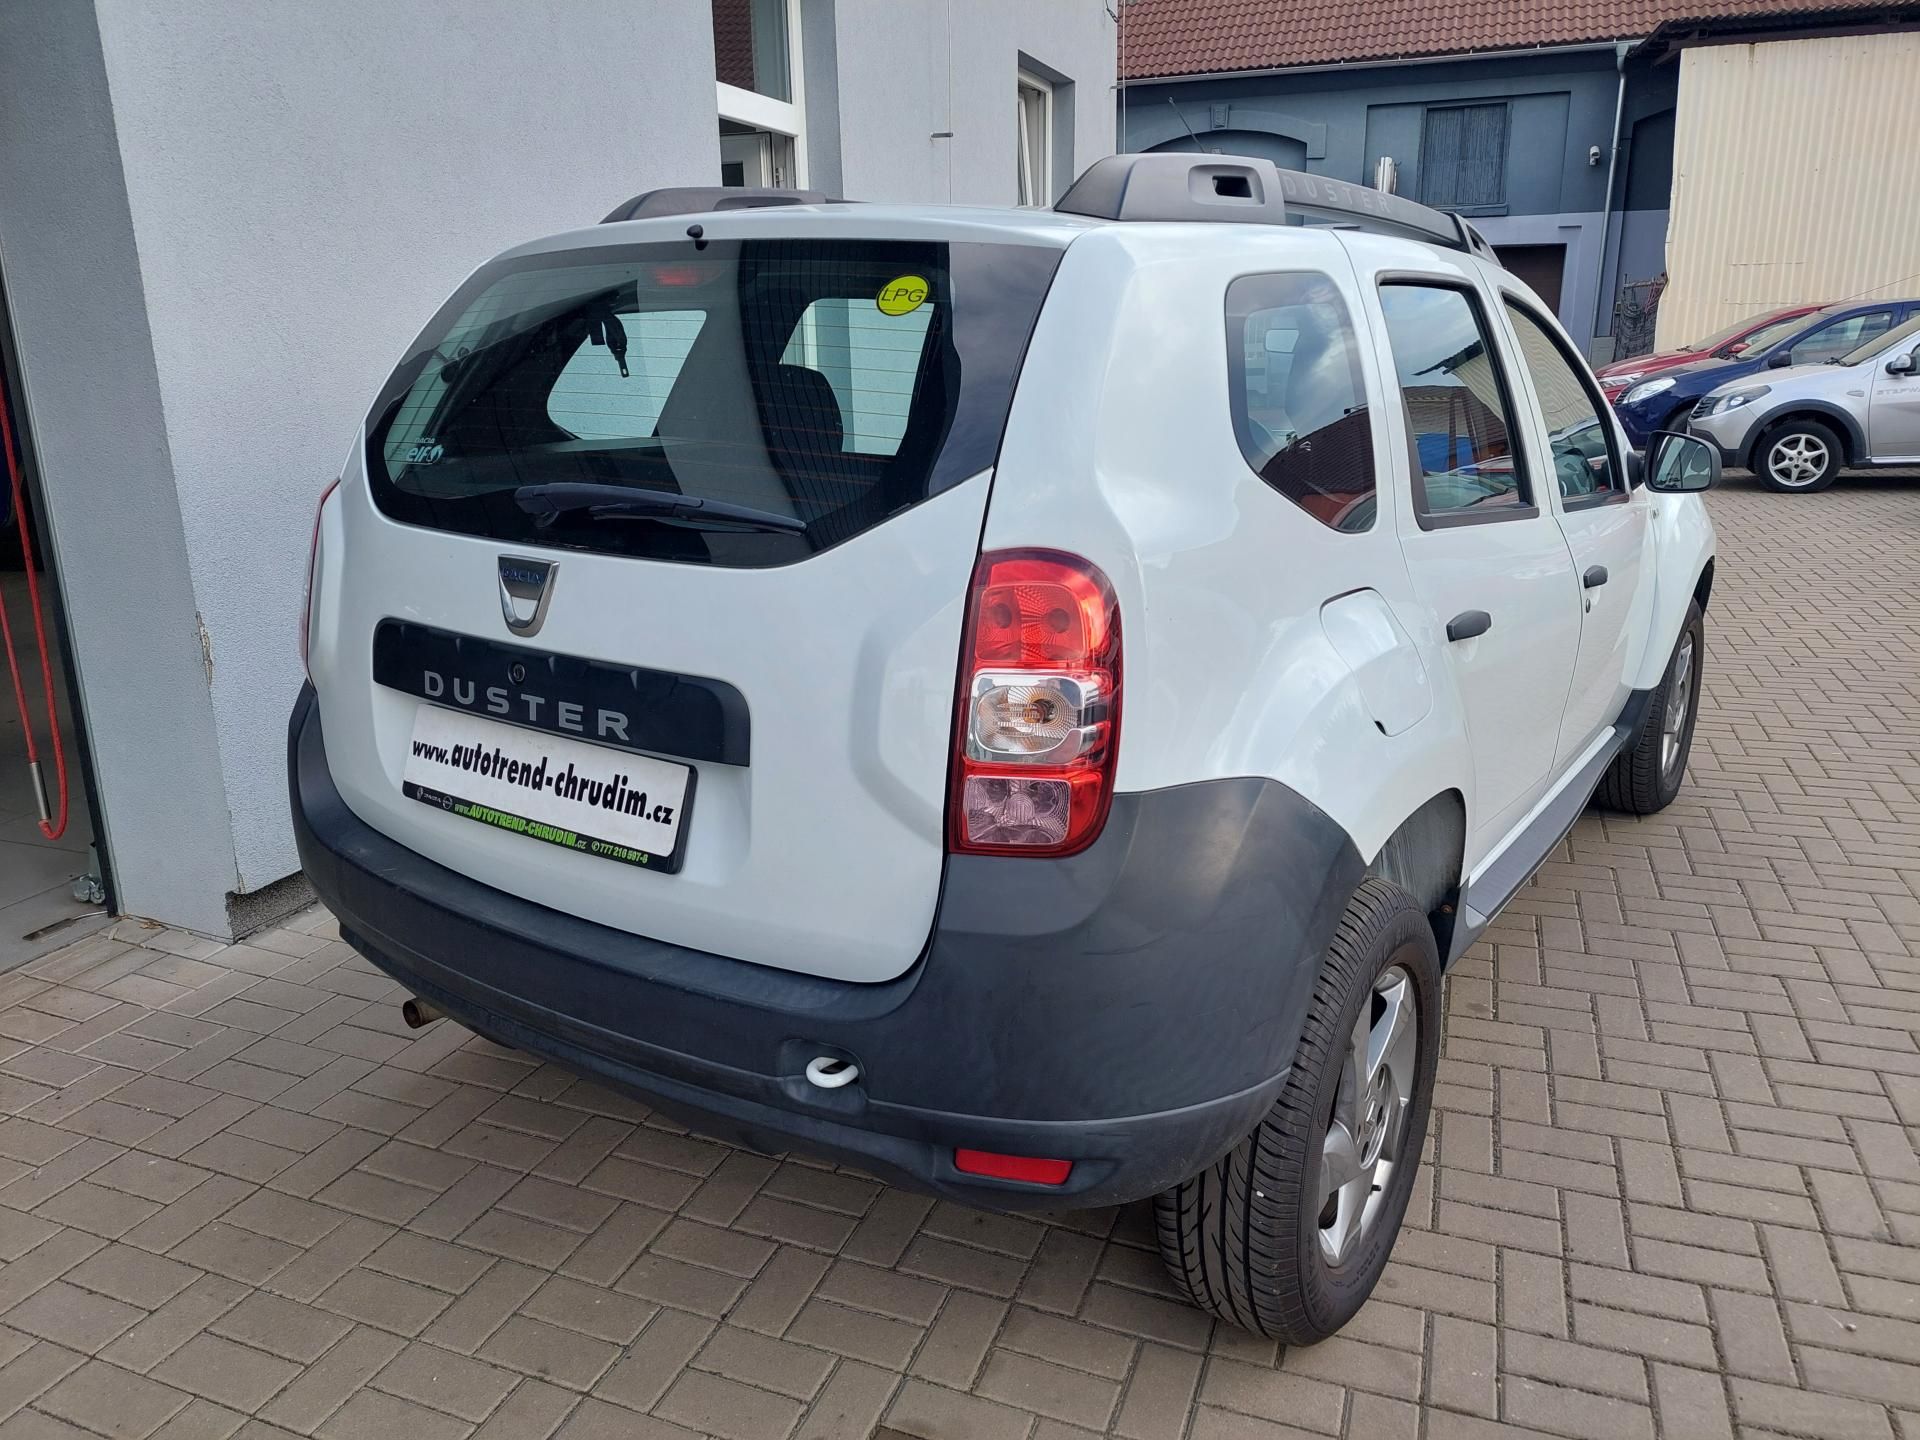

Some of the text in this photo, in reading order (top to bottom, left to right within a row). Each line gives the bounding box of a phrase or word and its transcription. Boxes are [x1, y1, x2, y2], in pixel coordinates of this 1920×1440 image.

[1284, 176, 1391, 214] DUSTER
[881, 287, 924, 303] LPG
[406, 446, 433, 463] elf
[423, 670, 630, 741] DUSTER
[412, 740, 675, 825] www.autotrend-chrudim.cz
[454, 804, 587, 849] www.AUTOTREND-CHRUDIM.cz
